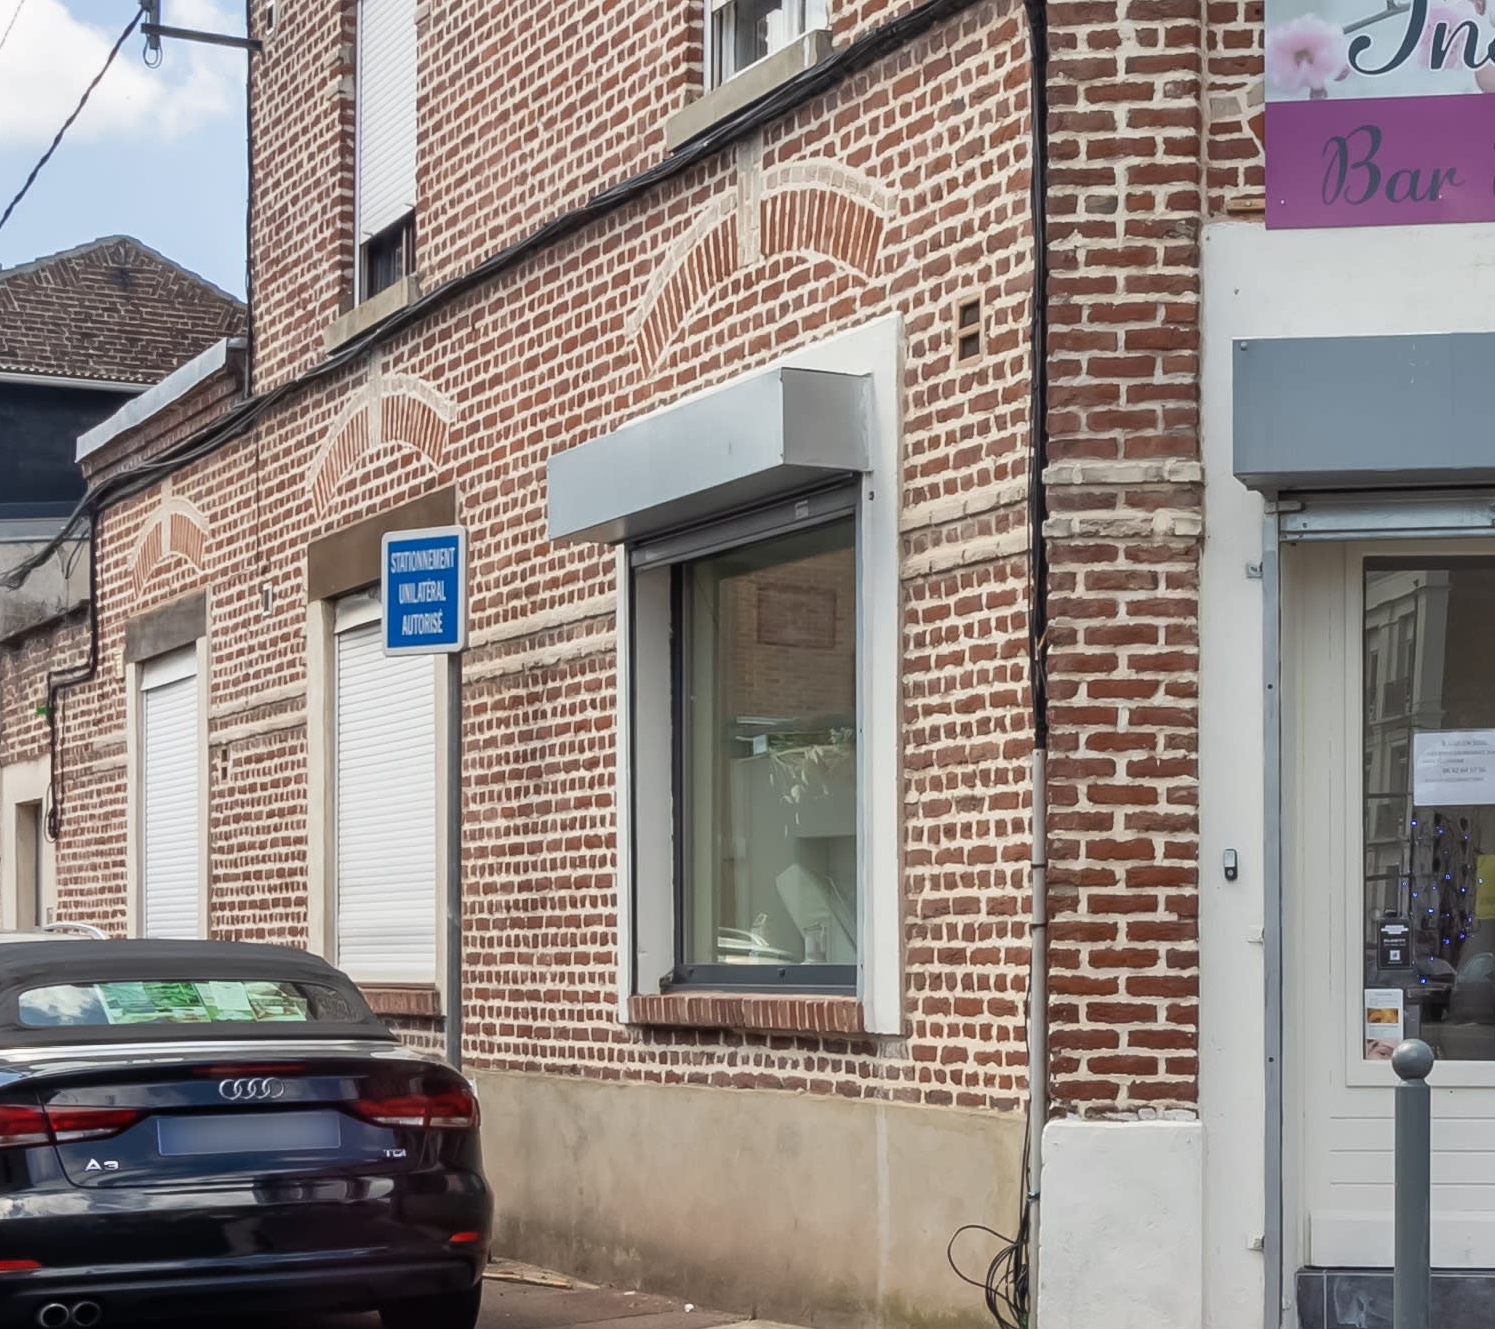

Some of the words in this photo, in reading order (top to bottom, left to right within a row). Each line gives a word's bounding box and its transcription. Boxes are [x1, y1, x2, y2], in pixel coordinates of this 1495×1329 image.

[1321, 125, 1465, 206] Bar
[390, 547, 456, 574] STATIONNEMENT
[398, 578, 447, 605] UNILATÉRAL
[401, 608, 444, 636] AUTORISÉ
[85, 1158, 119, 1171] A3
[382, 1148, 406, 1157] TDI
